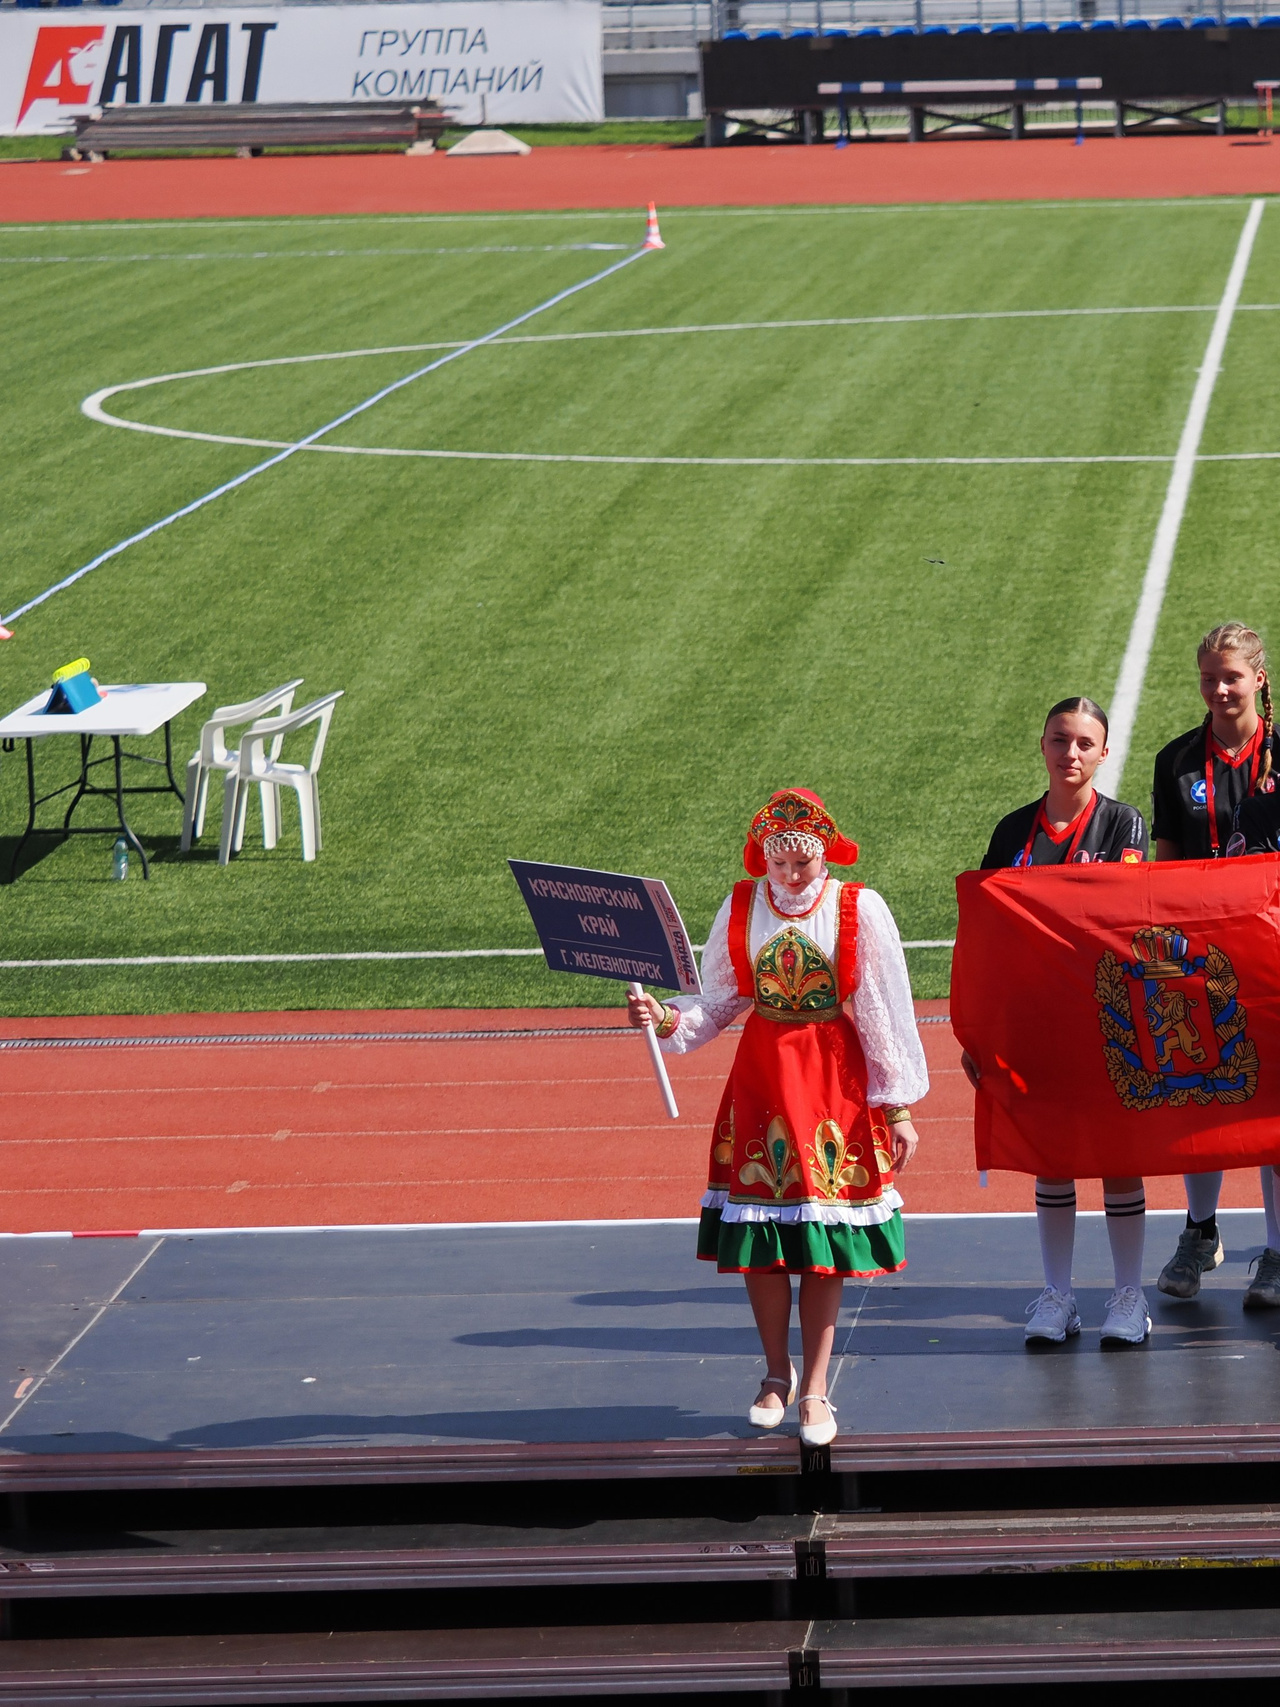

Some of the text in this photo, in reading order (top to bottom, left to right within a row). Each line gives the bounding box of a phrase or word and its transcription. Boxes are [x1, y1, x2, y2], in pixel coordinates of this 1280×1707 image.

[359, 27, 488, 57] ГРУППА
[99, 22, 279, 104] АГАТ
[352, 60, 543, 97] КОМПАНИЙ
[527, 877, 644, 911] КРАСНОЯРСКИЙ
[577, 913, 620, 938] КРАЙ
[560, 949, 664, 981] Г. ЖЕЛЕЗНОГОРСК
